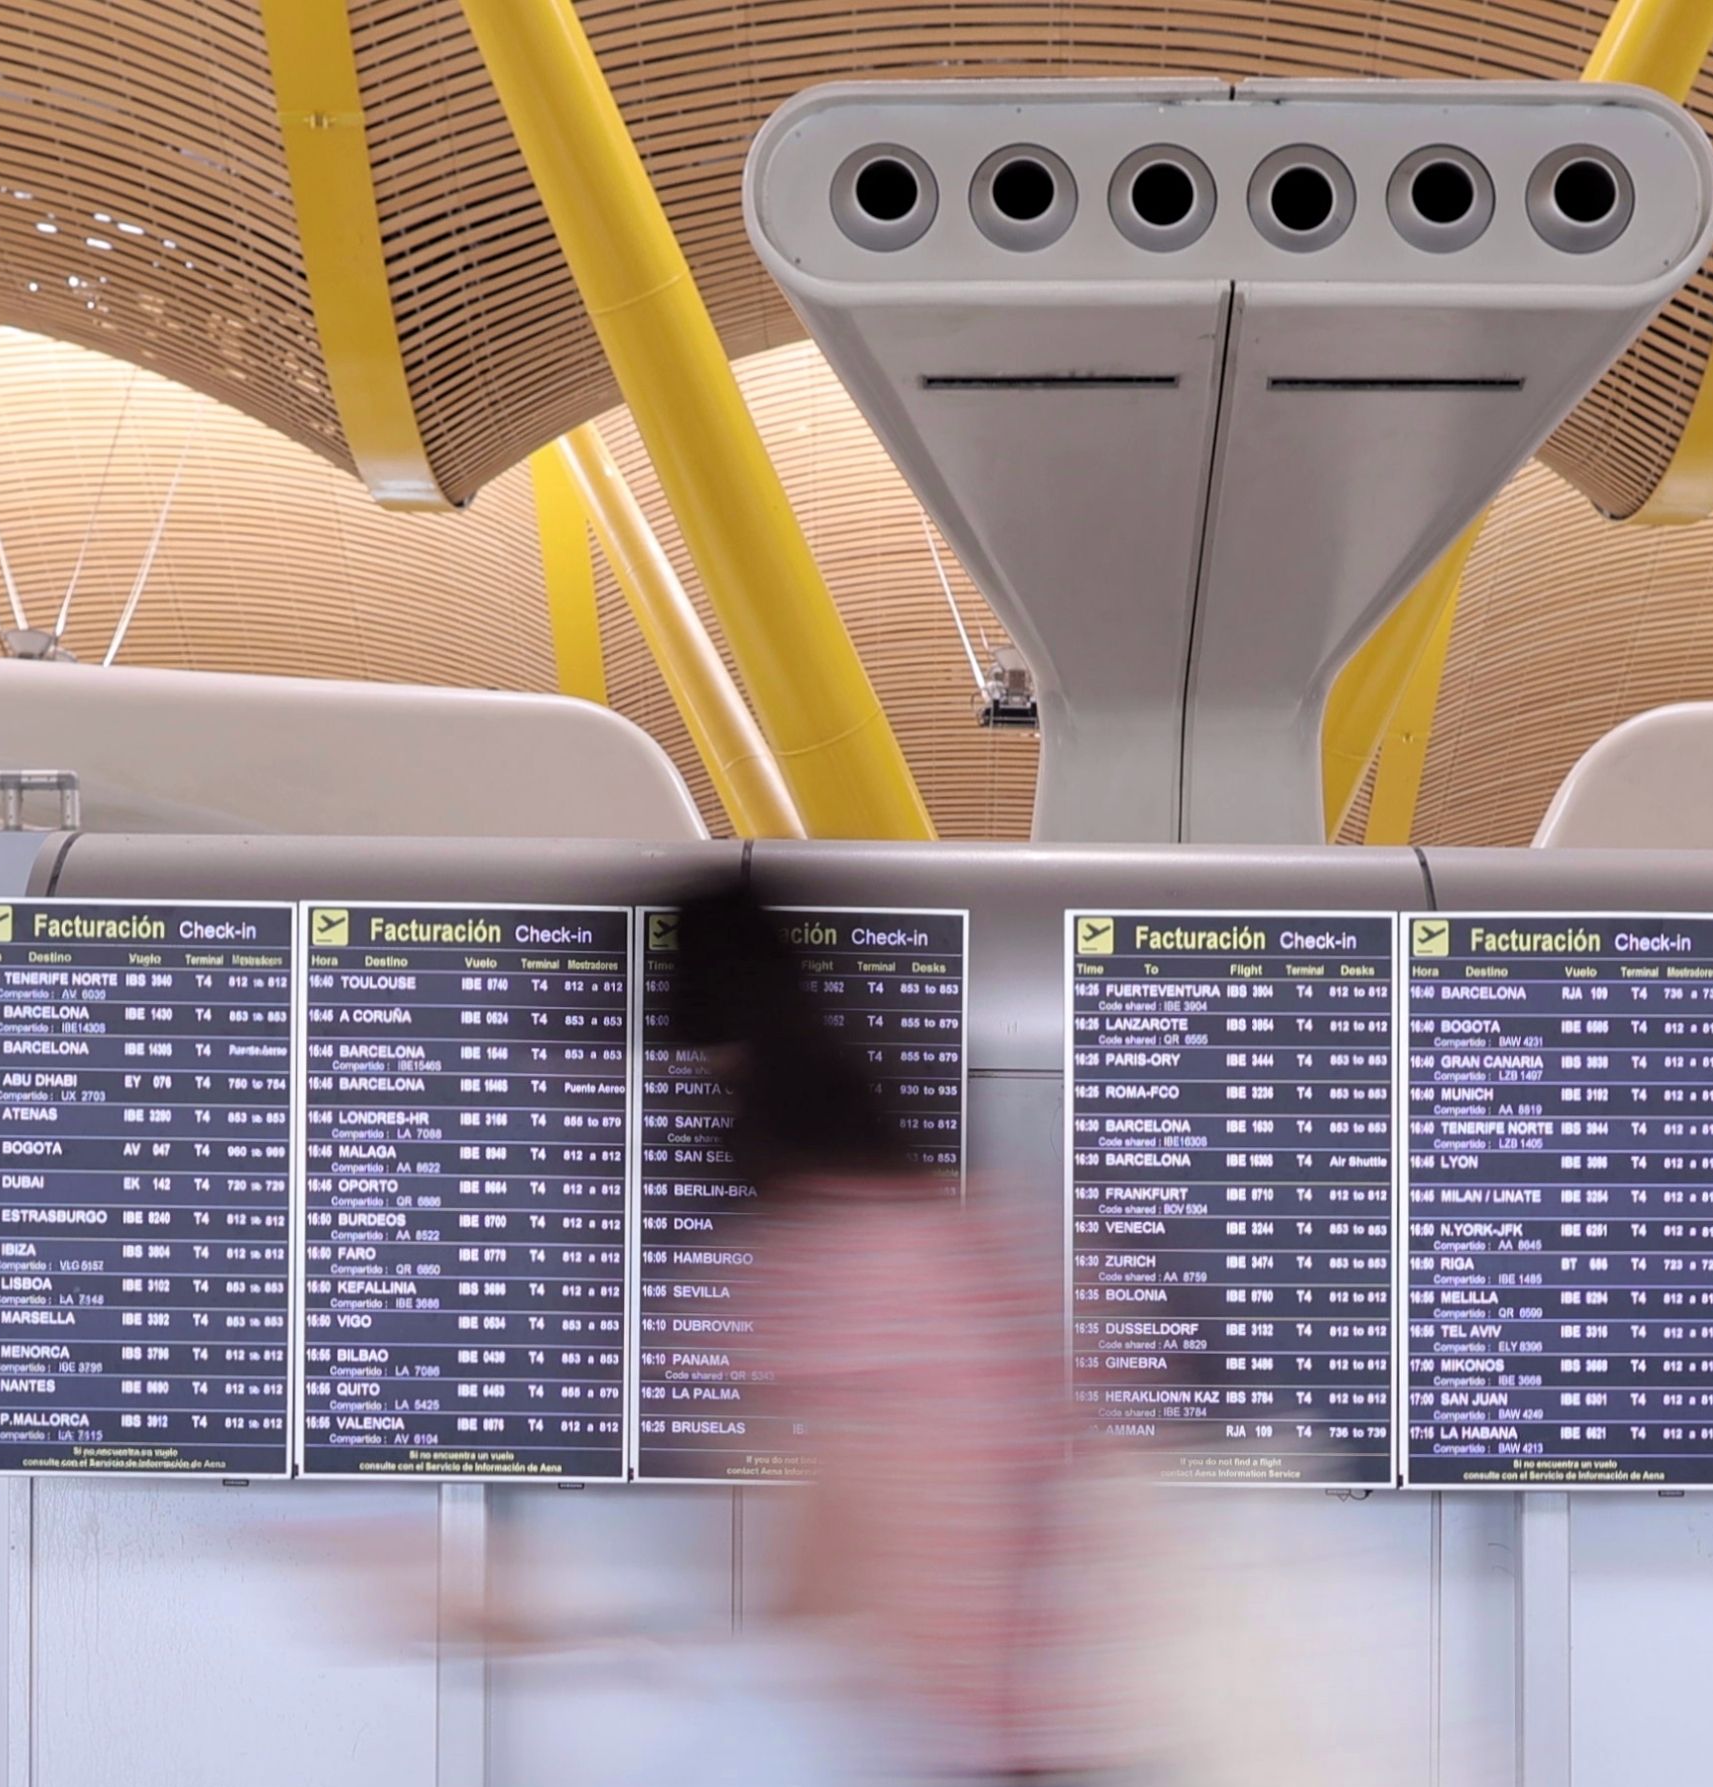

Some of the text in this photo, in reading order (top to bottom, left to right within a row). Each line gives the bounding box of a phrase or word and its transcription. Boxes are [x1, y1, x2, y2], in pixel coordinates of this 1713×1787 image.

[34, 914, 257, 940] Facturación Check-in
[370, 918, 592, 943] Facturación Check-in
[851, 929, 928, 947] Check-in
[1135, 925, 1357, 950] Facturación Check-in
[1470, 928, 1691, 952] Facturación Check-in
[28, 952, 72, 963] Destino
[185, 954, 224, 966] Terminal
[311, 955, 618, 970] Hora Destino Vuelo Terminal Mostradores
[801, 960, 946, 973] Flight Terminal Desks
[1077, 963, 1375, 977] Time To Flight Terminal Desks
[1412, 966, 1439, 977] Hora
[1465, 966, 1509, 977] Destino
[1564, 966, 1597, 978] Vuelo
[1621, 967, 1659, 978] Terminal
[5, 973, 118, 986] TENERIFE NORTE
[341, 976, 416, 990] TOULOUSE
[867, 982, 959, 995] T4 853 to 853
[1105, 984, 1221, 998] FUERTEVENTURA
[1441, 987, 1526, 1000] BARCELONA
[3, 1006, 89, 1019] BARCELONA
[339, 1008, 412, 1024] A CORUÑA
[1105, 1018, 1188, 1031] LANZAROTE
[1441, 1020, 1501, 1034] BOGOTA
[3, 1041, 89, 1055] BARCELONA
[339, 1045, 425, 1058] BARCELONA
[1105, 1053, 1180, 1067] PARIS-ORY
[1441, 1055, 1544, 1069] GRAN CANARIA
[2, 1074, 77, 1087] ABU DHABI
[339, 1078, 425, 1091] BARCELONA
[564, 1082, 596, 1094] Puente
[1105, 1086, 1179, 1099] ROMA-FCO
[1441, 1088, 1494, 1101] MUNICH
[2, 1108, 58, 1121] ATENAS
[338, 1112, 429, 1125] LONDRES-HR
[1105, 1120, 1191, 1133] BARCELONA
[1441, 1122, 1554, 1135] TENERIFE NORTE
[1, 1142, 62, 1155] BOGOTA
[338, 1146, 396, 1159] MALAGA
[1105, 1153, 1387, 1168] BARCELONA Air Shuttle
[1441, 1156, 1478, 1169] LYON
[1, 1176, 44, 1189] DUBAI
[338, 1179, 398, 1193] OPORTO
[1105, 1187, 1188, 1201] FRANKFURT
[1441, 1189, 1541, 1203] MILAN LINATE
[1, 1210, 108, 1224] ESTRASBURGO
[338, 1213, 406, 1227] BURDEOS
[673, 1218, 713, 1231] DOHA
[1105, 1221, 1165, 1234] VENECIA
[1441, 1224, 1523, 1237] N.YORK-JFK
[1, 1244, 36, 1256] IBIZA
[338, 1247, 376, 1260] FARO
[673, 1252, 753, 1265] HAMBURGO
[1105, 1255, 1156, 1268] ZURICH
[1440, 1258, 1474, 1271] RIGA
[1, 1278, 53, 1290] LISBOA
[337, 1281, 416, 1294] KEFALLINIA
[673, 1286, 730, 1298] SEVILLA
[1105, 1289, 1167, 1302] BOLONIA
[1441, 1291, 1498, 1304] MELILLA
[1, 1312, 75, 1325] MARSELLA
[337, 1315, 372, 1328] VIGO
[673, 1319, 754, 1333] DUBROVNIK
[1105, 1322, 1199, 1336] DUSSELDORF
[1441, 1325, 1501, 1338] TEL AVIV
[0, 1345, 70, 1359] MENORCA
[337, 1349, 389, 1362] BILBAO
[672, 1354, 730, 1366] PANAMA
[1105, 1356, 1167, 1369] GINEBRA
[1441, 1359, 1505, 1372] MIKONOS
[0, 1379, 56, 1393] NANTES
[336, 1383, 380, 1397] QUITO
[672, 1388, 740, 1401] LA PALMA
[1105, 1390, 1220, 1404] HERAKLION/N KAZ
[1441, 1393, 1508, 1406] SAN JUAN
[0, 1413, 89, 1426] P.MALLORCA
[336, 1417, 404, 1430] VALENCIA
[671, 1421, 746, 1434] BRUSELAS
[1106, 1424, 1155, 1437] AMMAN
[1440, 1427, 1518, 1440] LA HABANA
